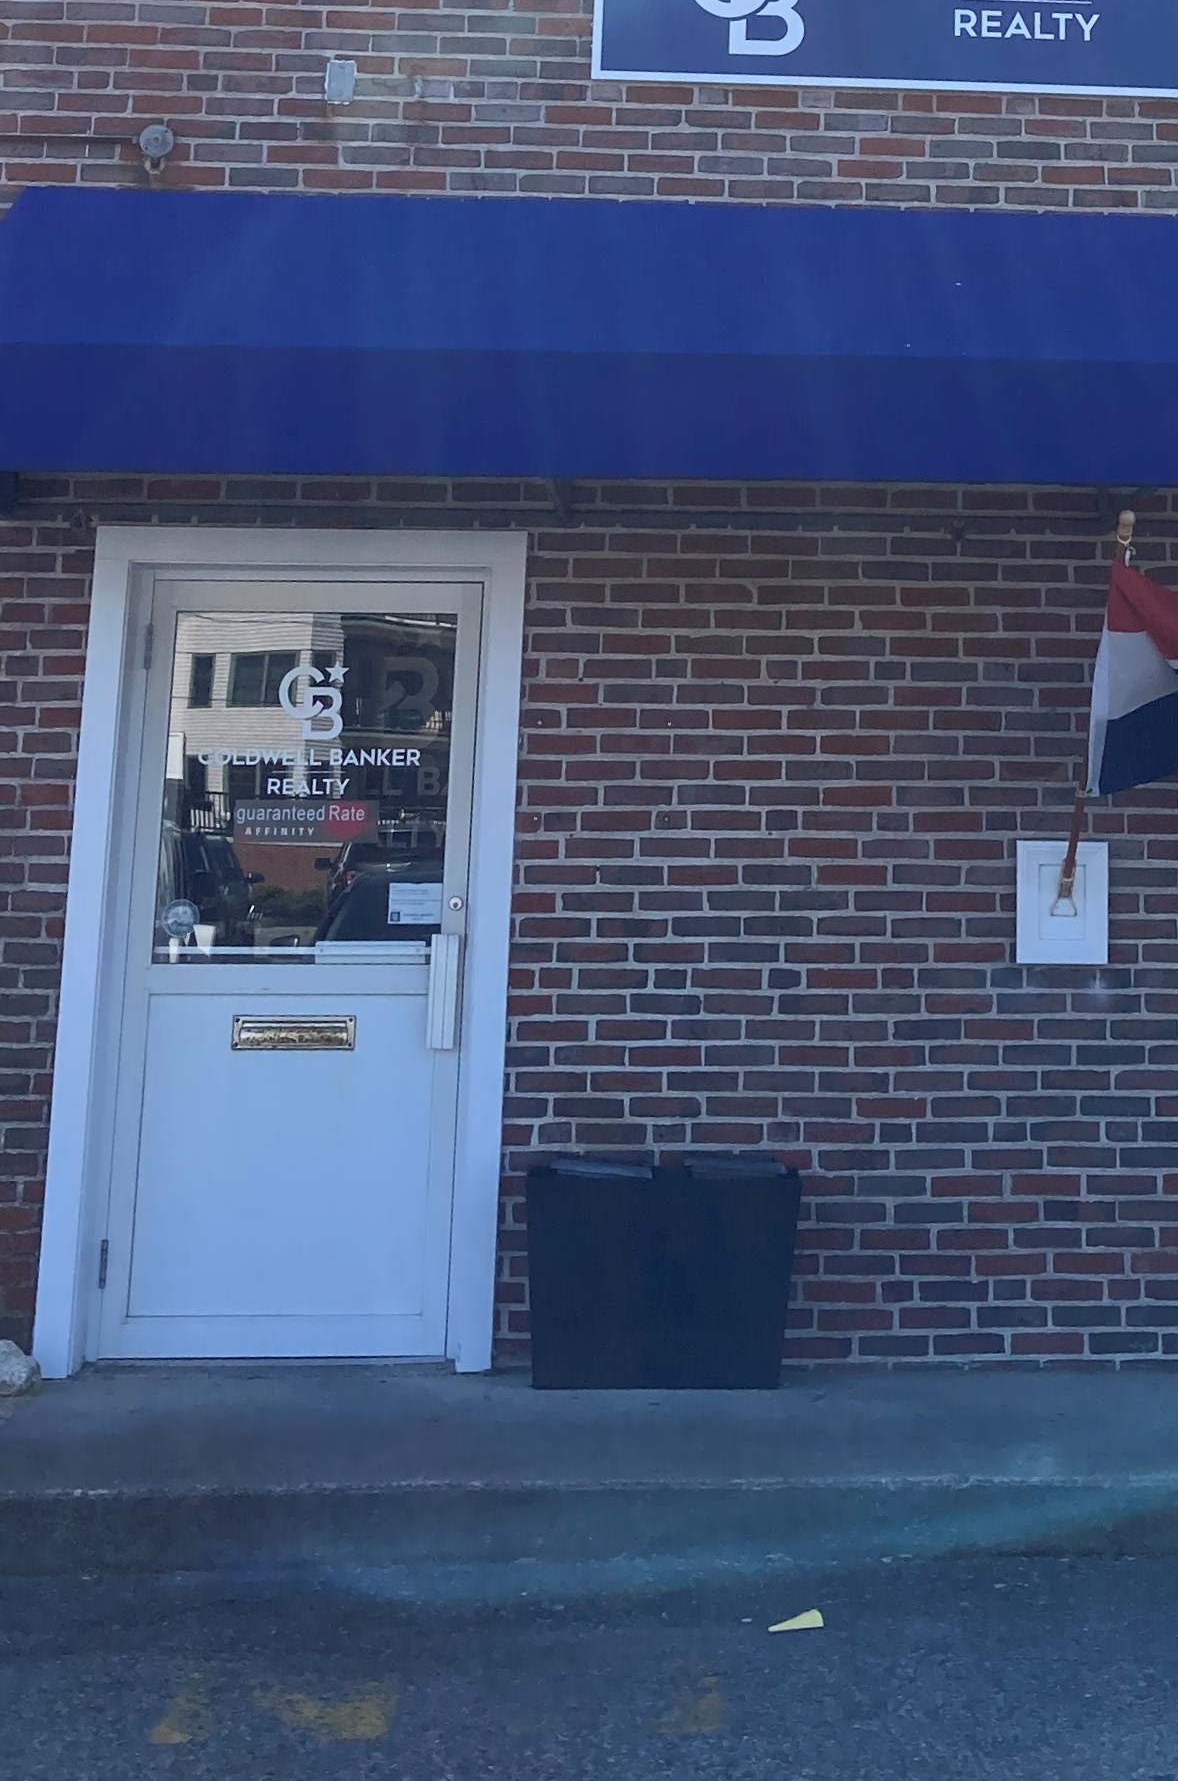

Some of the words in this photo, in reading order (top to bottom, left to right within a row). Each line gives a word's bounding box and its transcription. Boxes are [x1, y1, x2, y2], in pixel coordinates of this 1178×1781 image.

[953, 8, 1101, 43] REALTY
[278, 665, 343, 740] CB
[197, 747, 322, 767] COLDWELL
[329, 748, 421, 767] BANKER
[266, 778, 350, 796] REALTY
[236, 805, 325, 824] guaranteed
[328, 805, 365, 822] Rate
[245, 827, 315, 836] AFFINITY
